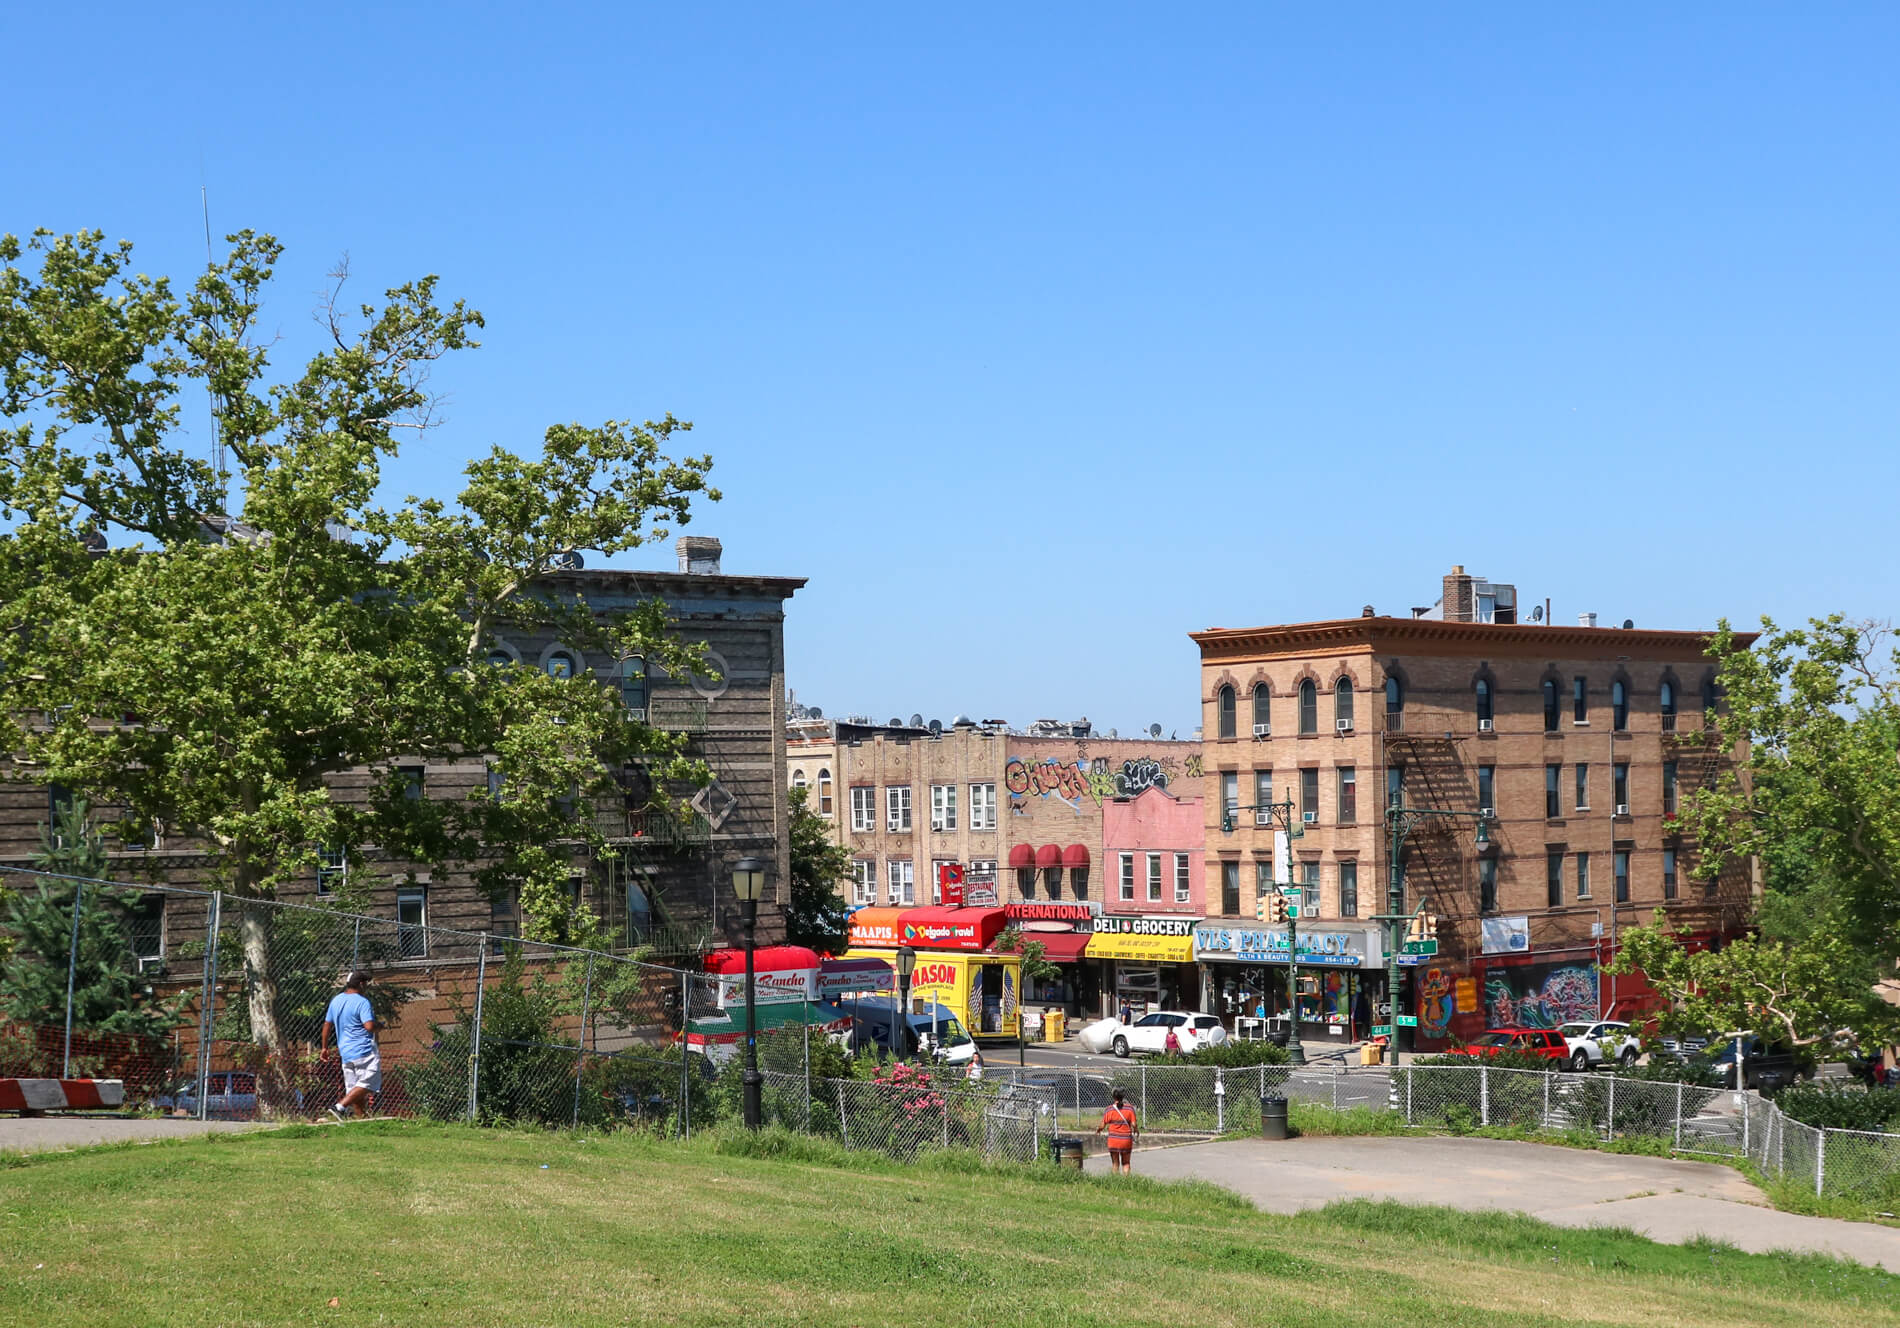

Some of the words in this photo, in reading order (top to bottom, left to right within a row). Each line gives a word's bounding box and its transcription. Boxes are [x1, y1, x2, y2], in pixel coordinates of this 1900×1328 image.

[1005, 904, 1091, 919] INTERNATIONAL
[852, 926, 892, 938] MAAPIS
[917, 925, 950, 939] Delgado
[951, 926, 974, 937] Travel
[1094, 919, 1120, 933] DELI
[1133, 920, 1191, 935] GROCERY
[1197, 930, 1231, 950] VLS
[1264, 953, 1289, 961] BEAUTY
[758, 973, 805, 986] Rancho
[912, 964, 956, 987] MASON
